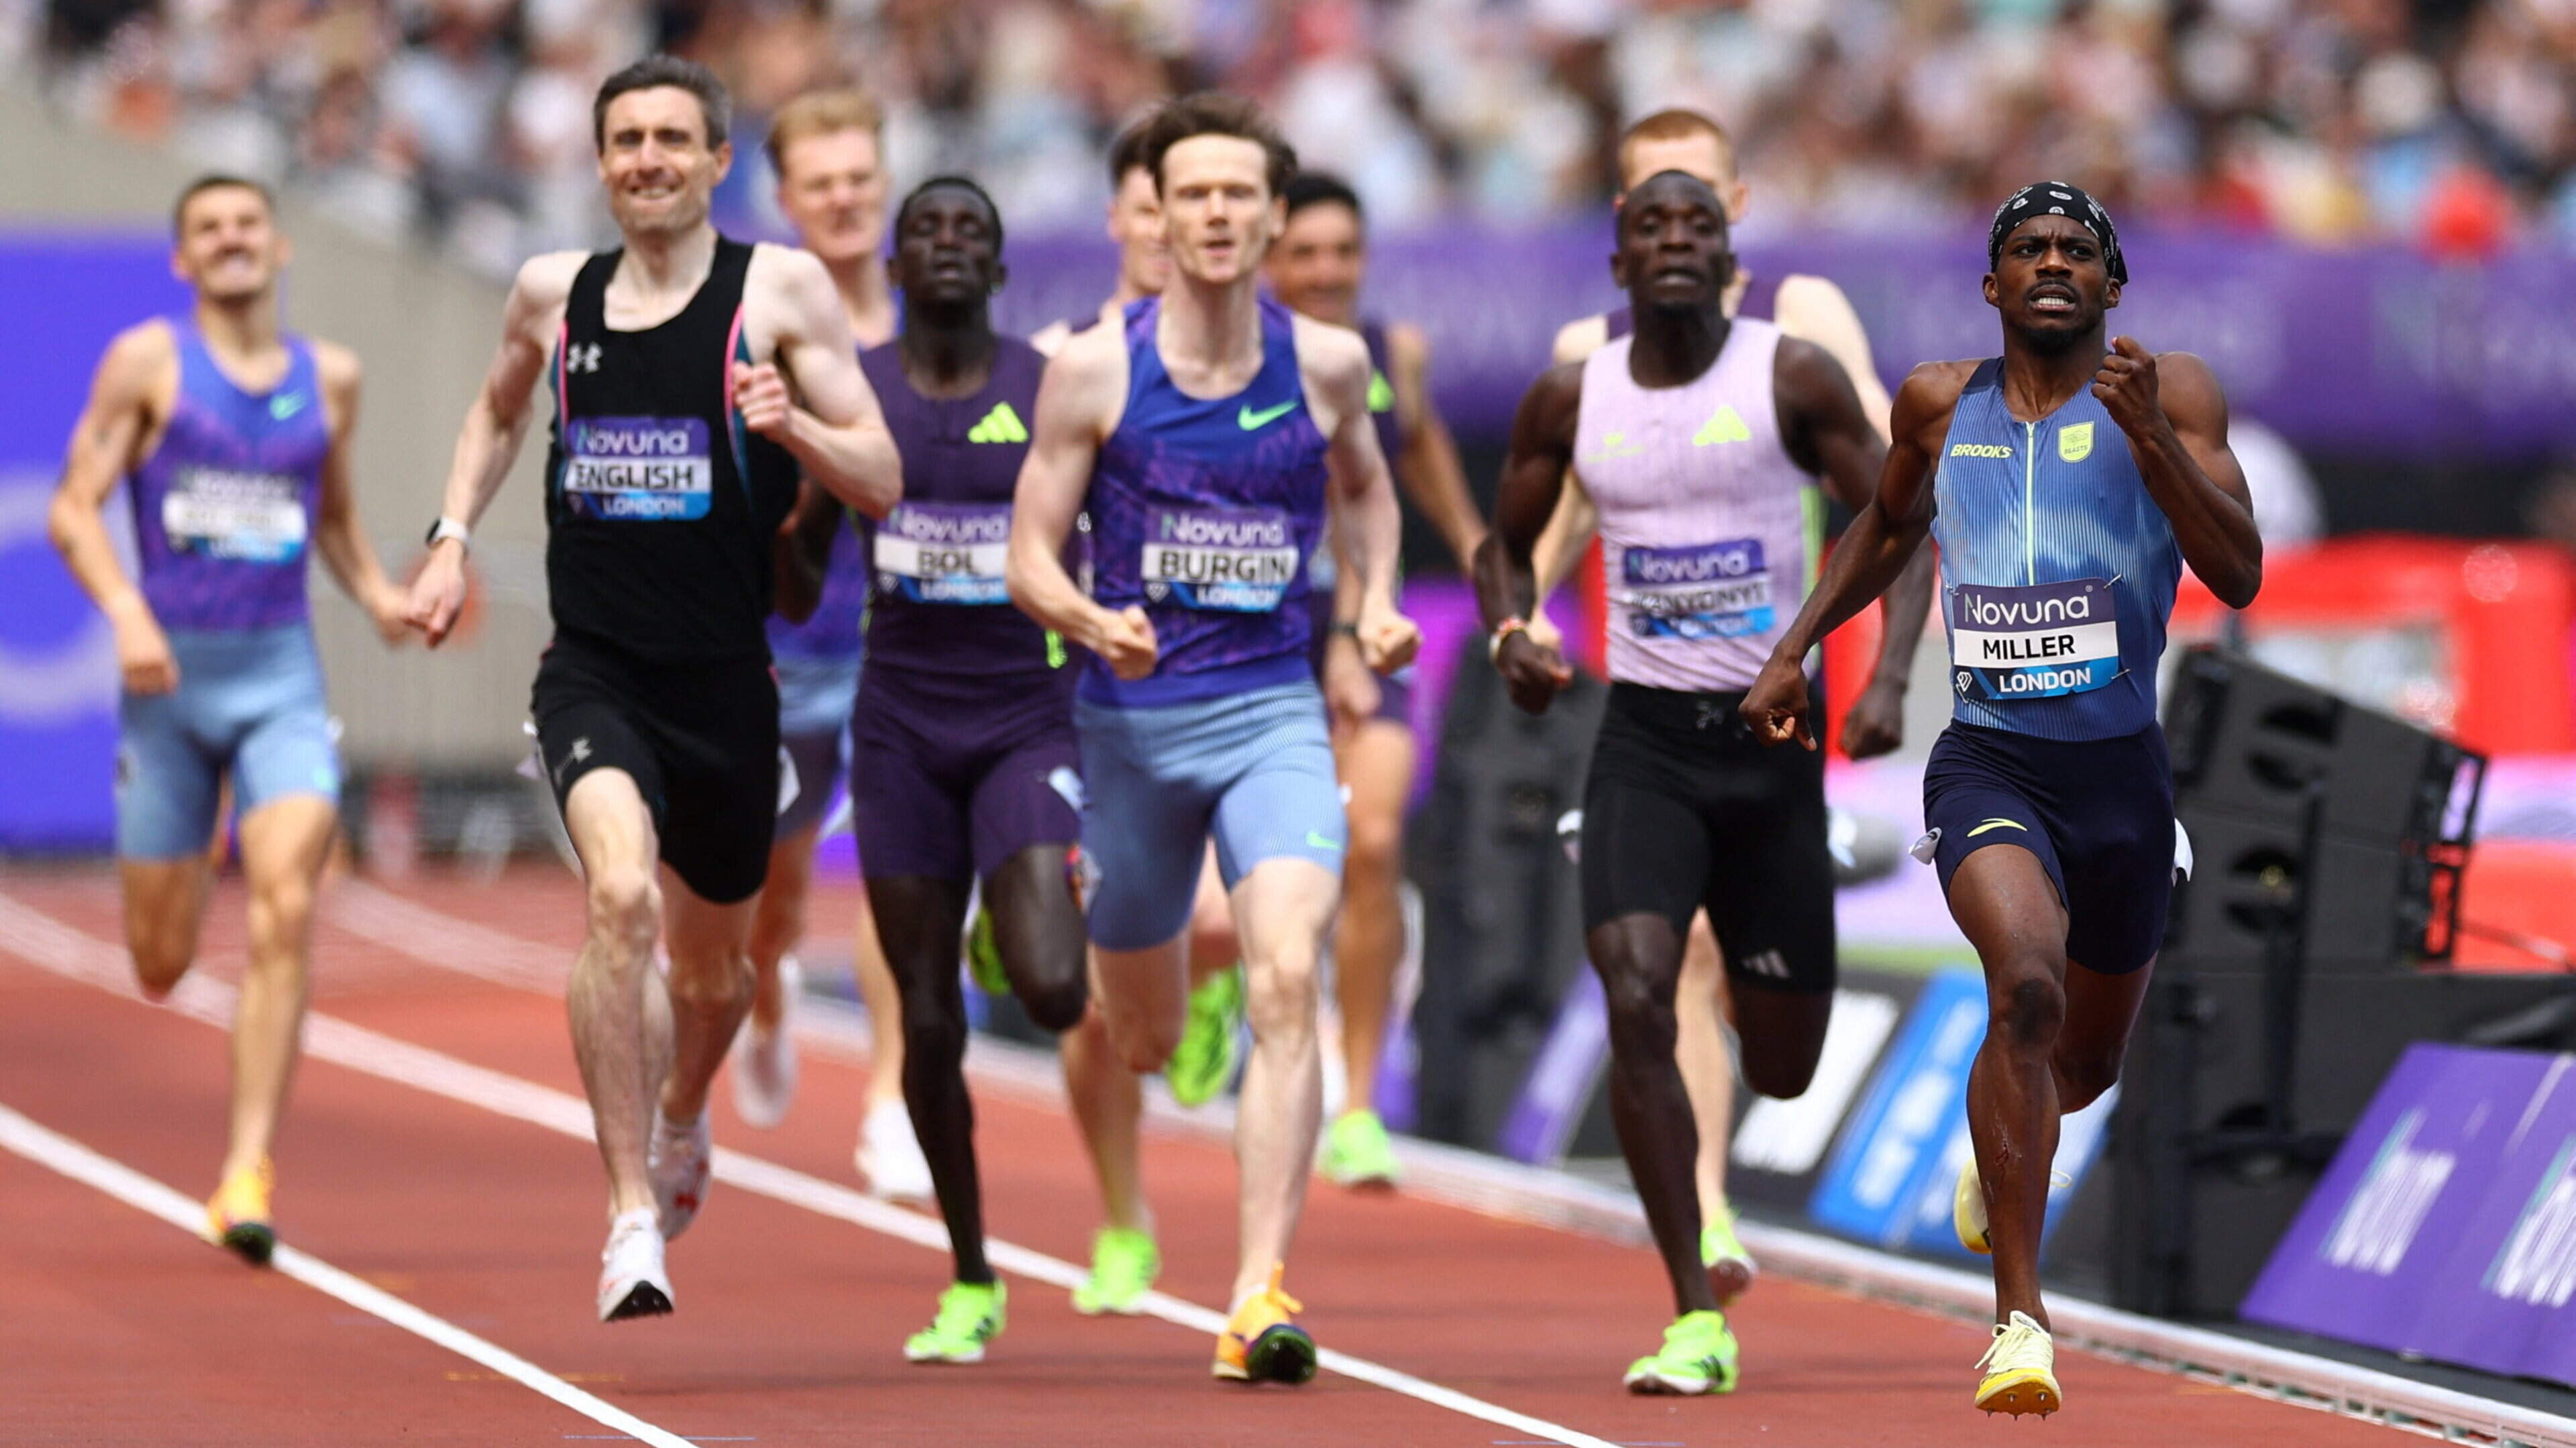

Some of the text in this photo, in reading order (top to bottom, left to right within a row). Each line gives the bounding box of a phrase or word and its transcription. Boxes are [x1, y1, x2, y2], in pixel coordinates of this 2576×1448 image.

[578, 423, 689, 455] Novuna
[1950, 444, 2012, 458] BROOKS
[2064, 445, 2088, 455] BEASTS
[575, 464, 694, 490] ENGLISH
[603, 495, 685, 516] LONDON
[890, 507, 1007, 543] Novuna
[1161, 513, 1284, 547] Novuna
[920, 550, 979, 578] BOL
[1161, 551, 1287, 581] BURGIN
[1983, 634, 2076, 660] MILLER
[1999, 667, 2091, 692] LONDON
